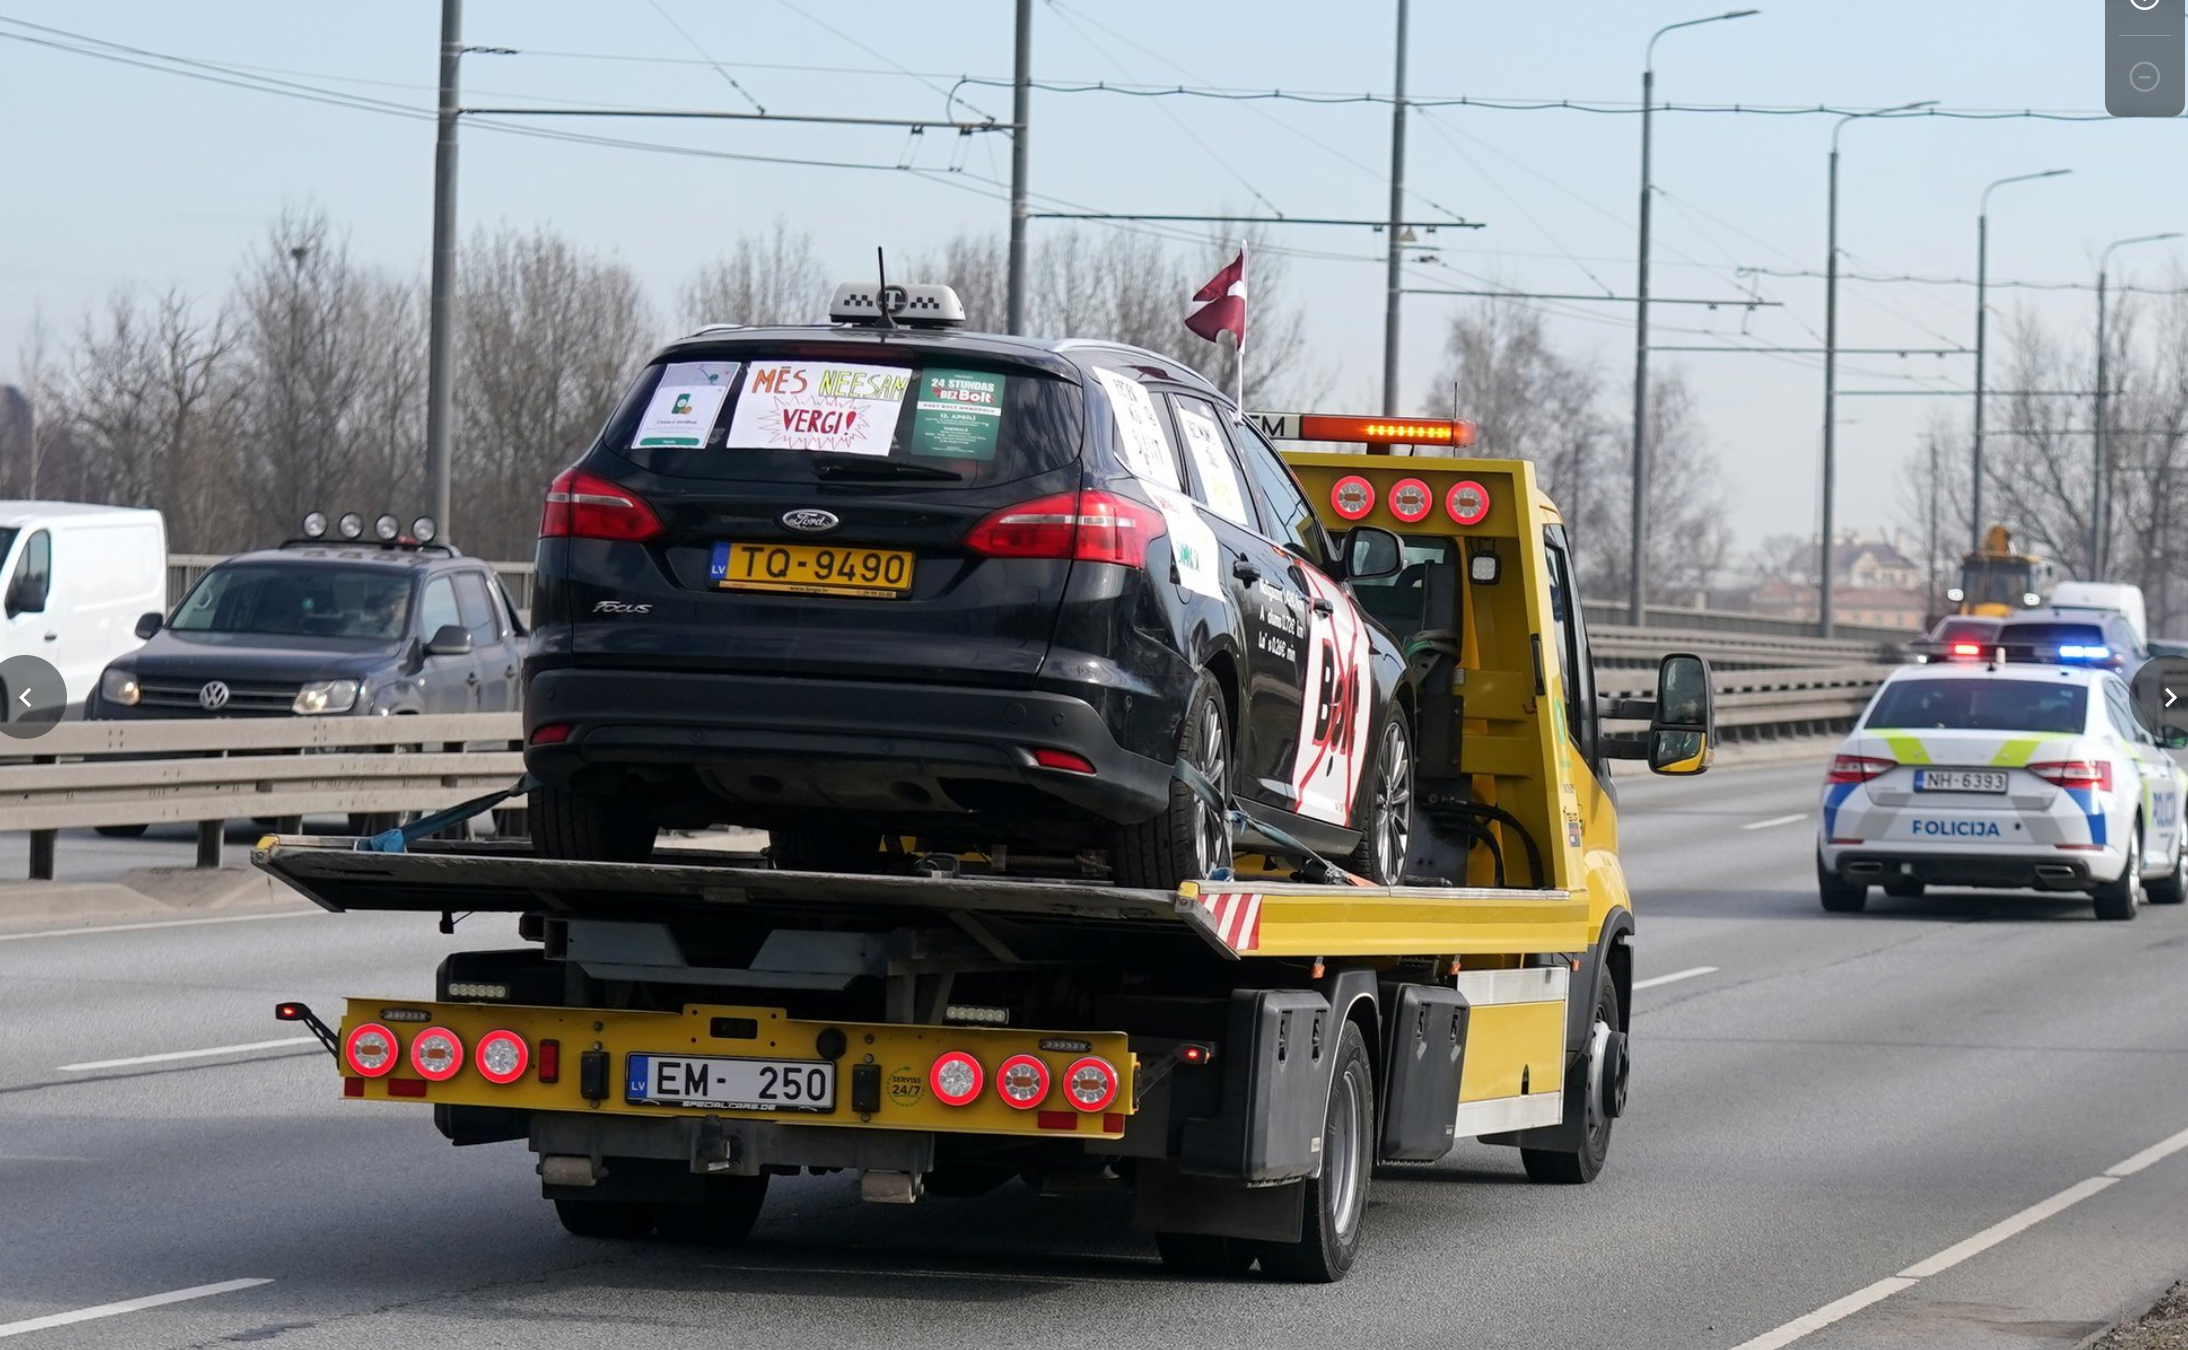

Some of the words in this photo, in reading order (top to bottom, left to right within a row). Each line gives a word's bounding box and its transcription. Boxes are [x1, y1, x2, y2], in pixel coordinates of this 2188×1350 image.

[752, 366, 808, 395] MĒS
[818, 369, 909, 400] NEESAM
[931, 378, 945, 388] 24
[948, 379, 995, 392] STUNDAS
[940, 390, 958, 400] BEZ
[958, 389, 992, 403] Bolt
[783, 408, 857, 435] VERGI!
[793, 512, 825, 527] Ford
[711, 565, 726, 575] LV
[741, 547, 905, 584] TQ-9490
[1927, 773, 2004, 789] NH-6393
[1912, 820, 2000, 836] POLICIJA
[631, 1081, 645, 1091] LV
[758, 1066, 826, 1101] 250
[892, 1075, 922, 1084] SERVISS
[892, 1084, 921, 1096] 24/7
[682, 1100, 777, 1111] SPECIALCARS.DE
